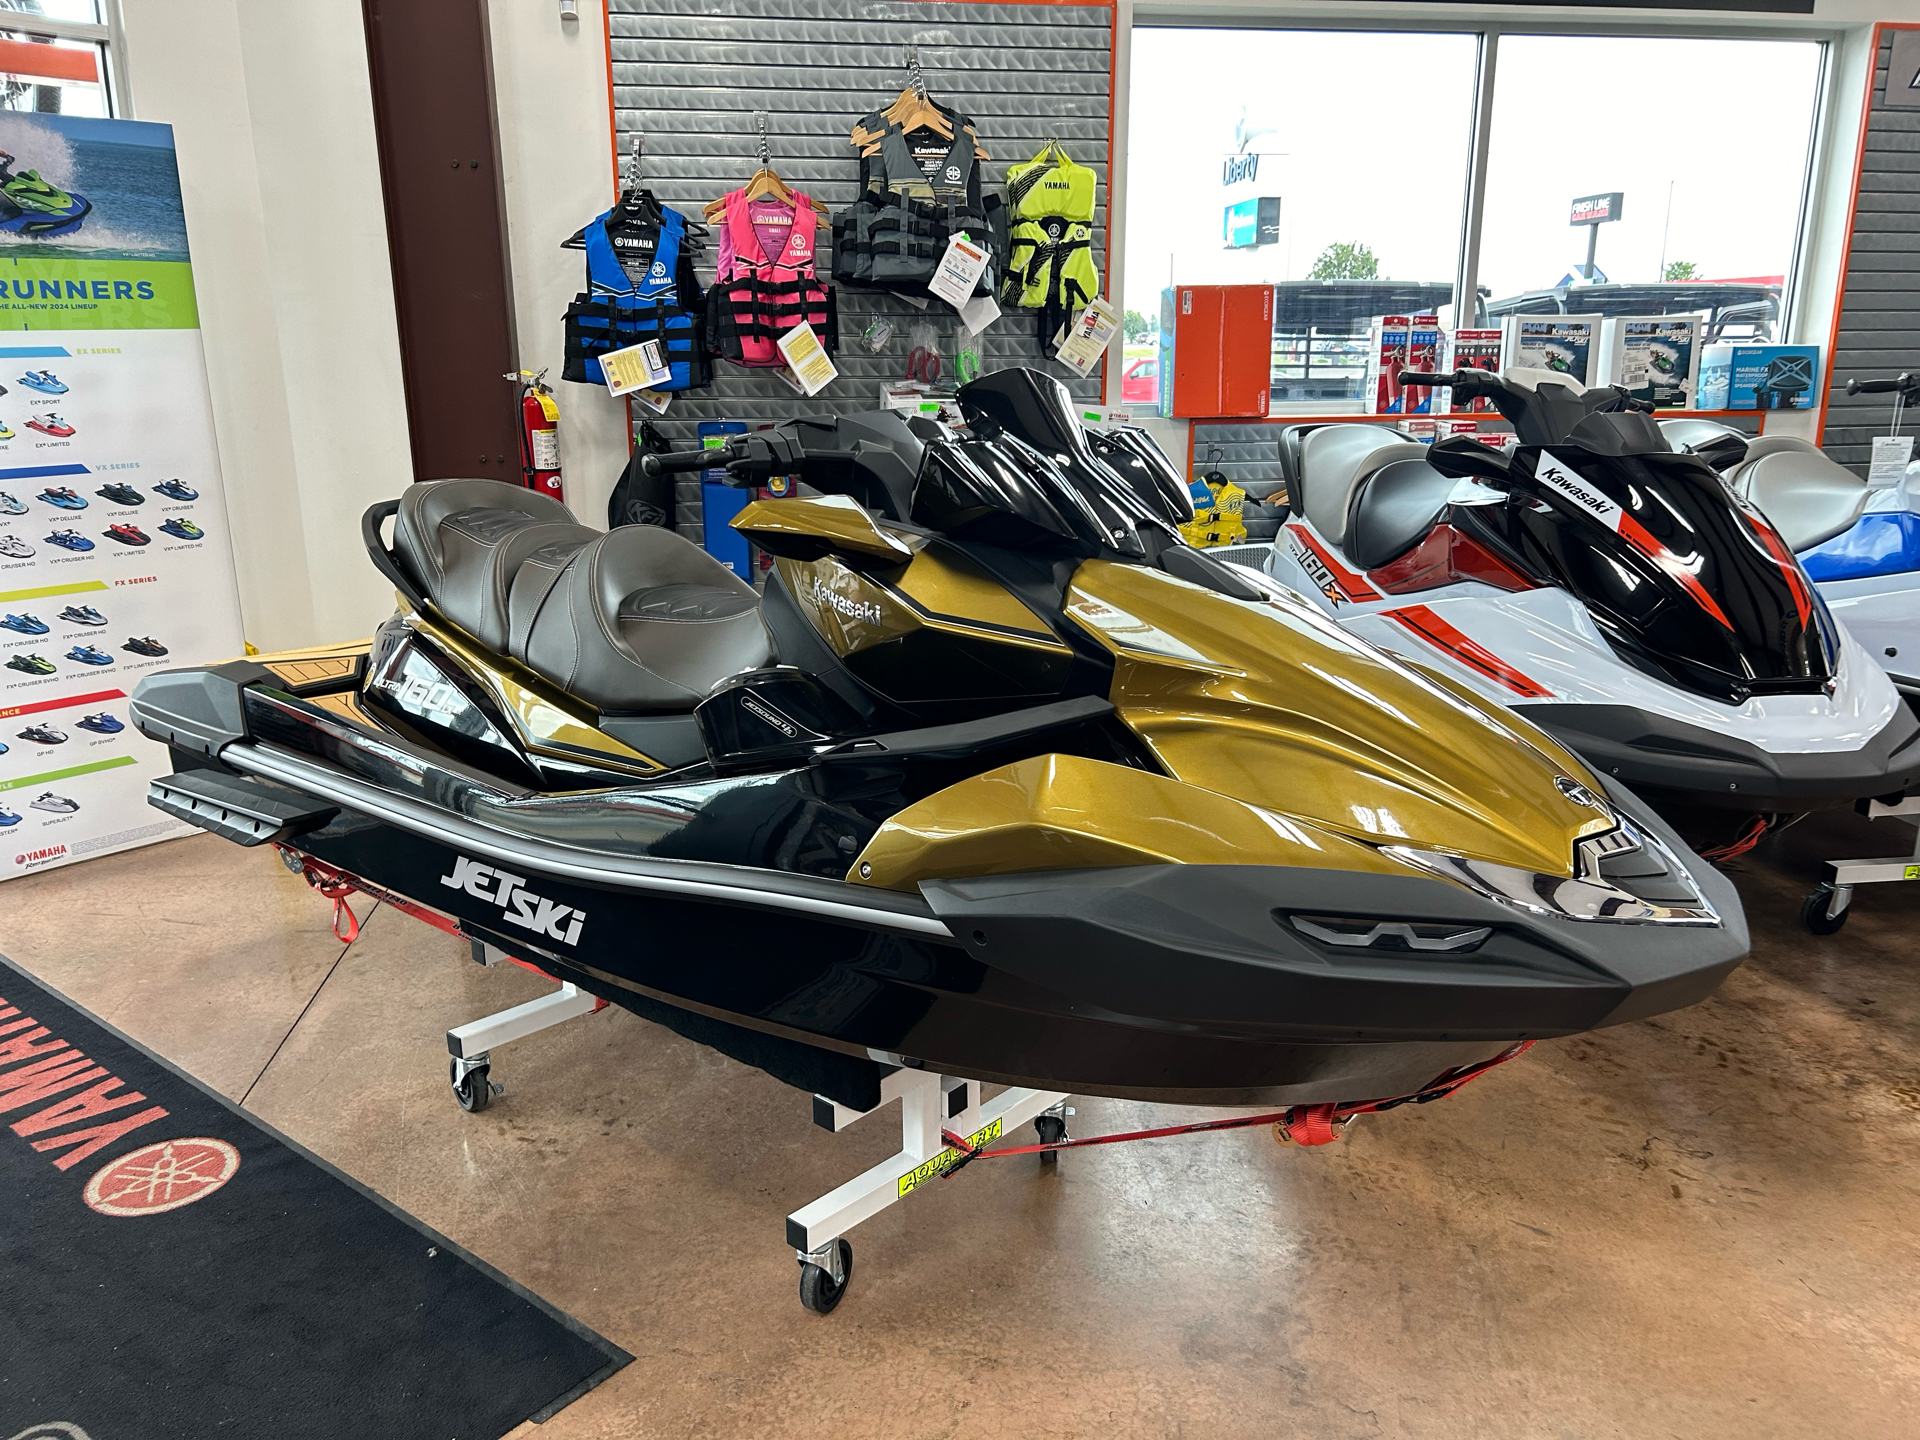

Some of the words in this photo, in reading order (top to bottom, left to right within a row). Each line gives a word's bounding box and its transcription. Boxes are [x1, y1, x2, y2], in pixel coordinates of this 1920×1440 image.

[1223, 154, 1260, 186] Liberty
[1044, 182, 1070, 190] YAMAHA
[764, 216, 792, 224] YAMAHA
[624, 238, 654, 248] YAMAHA
[649, 276, 672, 286] YAMAHA
[1552, 328, 1590, 336] Kawasaki
[1542, 467, 1614, 515] Kawasaki
[1289, 544, 1299, 558] STX
[128, 576, 158, 585] SERIES
[814, 576, 882, 627] Kawasaki
[134, 661, 155, 669] LIMITED
[77, 670, 100, 679] CRUISER
[18, 680, 42, 688] CRUISER
[746, 701, 781, 726] JETSOUND
[26, 845, 67, 862] YAMAHA
